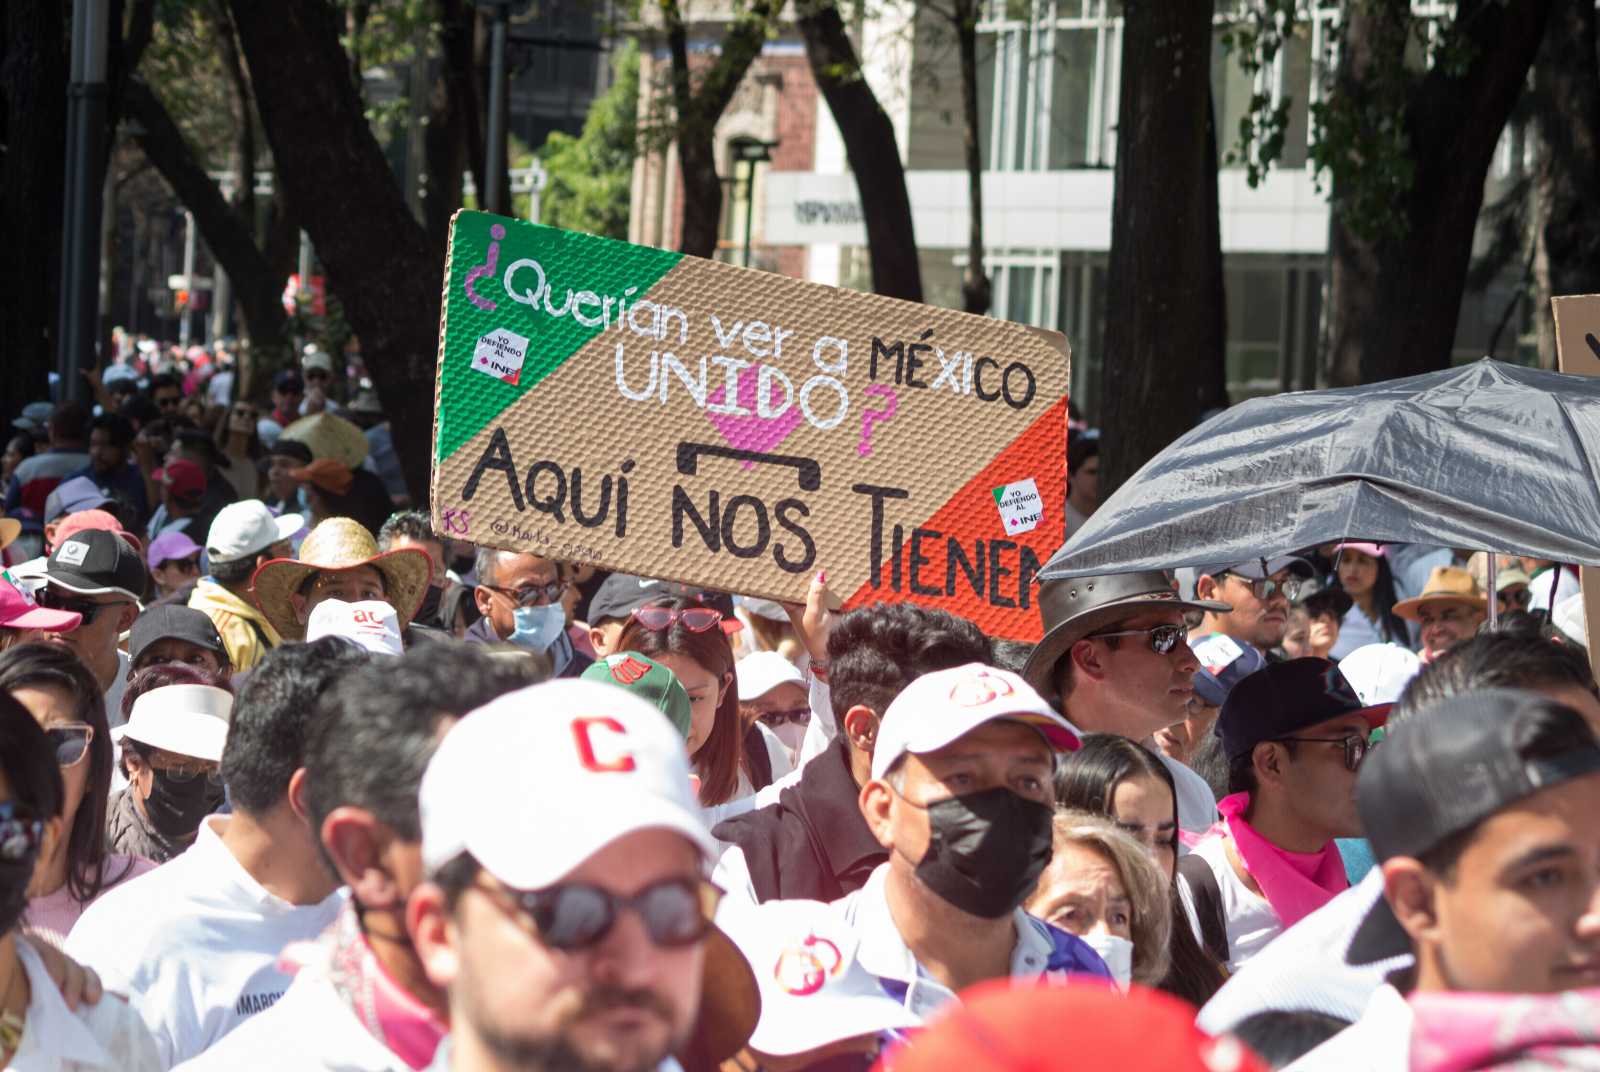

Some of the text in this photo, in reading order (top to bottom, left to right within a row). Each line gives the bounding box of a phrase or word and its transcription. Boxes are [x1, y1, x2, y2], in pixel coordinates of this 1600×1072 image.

[481, 336, 522, 358] DEFIENDO
[498, 335, 510, 345] YO
[494, 349, 505, 358] AL
[709, 313, 794, 359] ver
[813, 336, 849, 377] a
[869, 328, 1037, 410] MÉXICO
[462, 426, 635, 539] AQUÍ
[672, 484, 818, 574] NOS
[999, 493, 1037, 509] DEFIENDO
[1010, 490, 1021, 498] YO
[1016, 503, 1026, 511] AL
[570, 716, 637, 773] C
